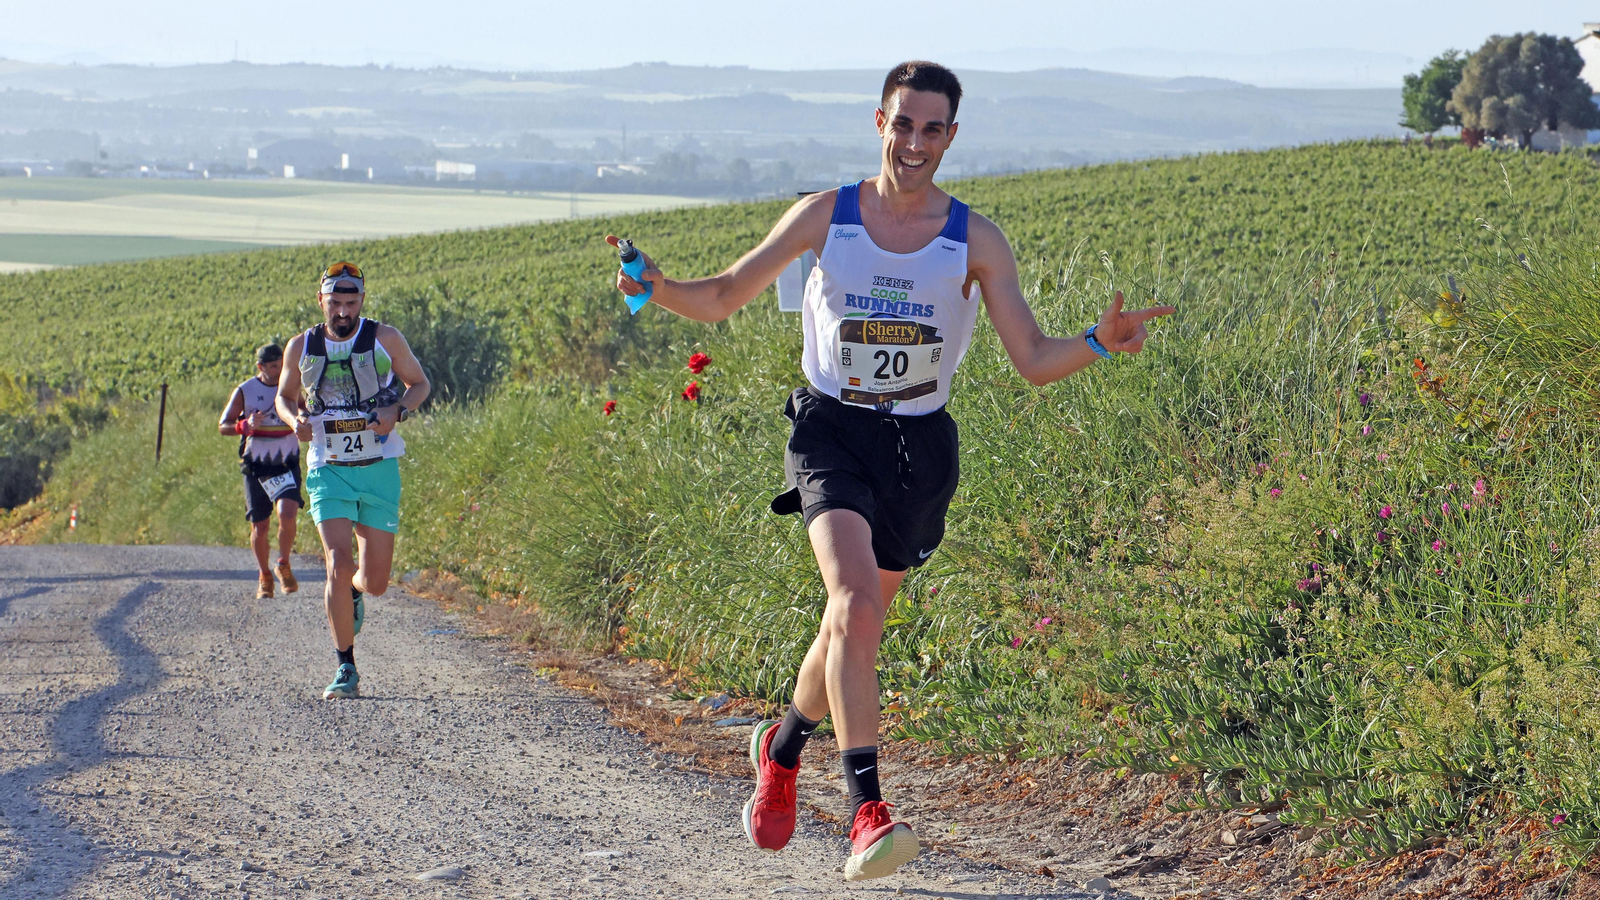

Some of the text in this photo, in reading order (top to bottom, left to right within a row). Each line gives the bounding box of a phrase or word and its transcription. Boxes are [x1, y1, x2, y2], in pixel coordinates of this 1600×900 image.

[835, 229, 858, 240] Clapper
[845, 294, 934, 317] RUNNERS
[868, 322, 917, 341] Sherry
[873, 350, 909, 379] 20
[338, 420, 365, 429] Sherry
[343, 434, 364, 453] 24
[270, 476, 286, 488] 185
